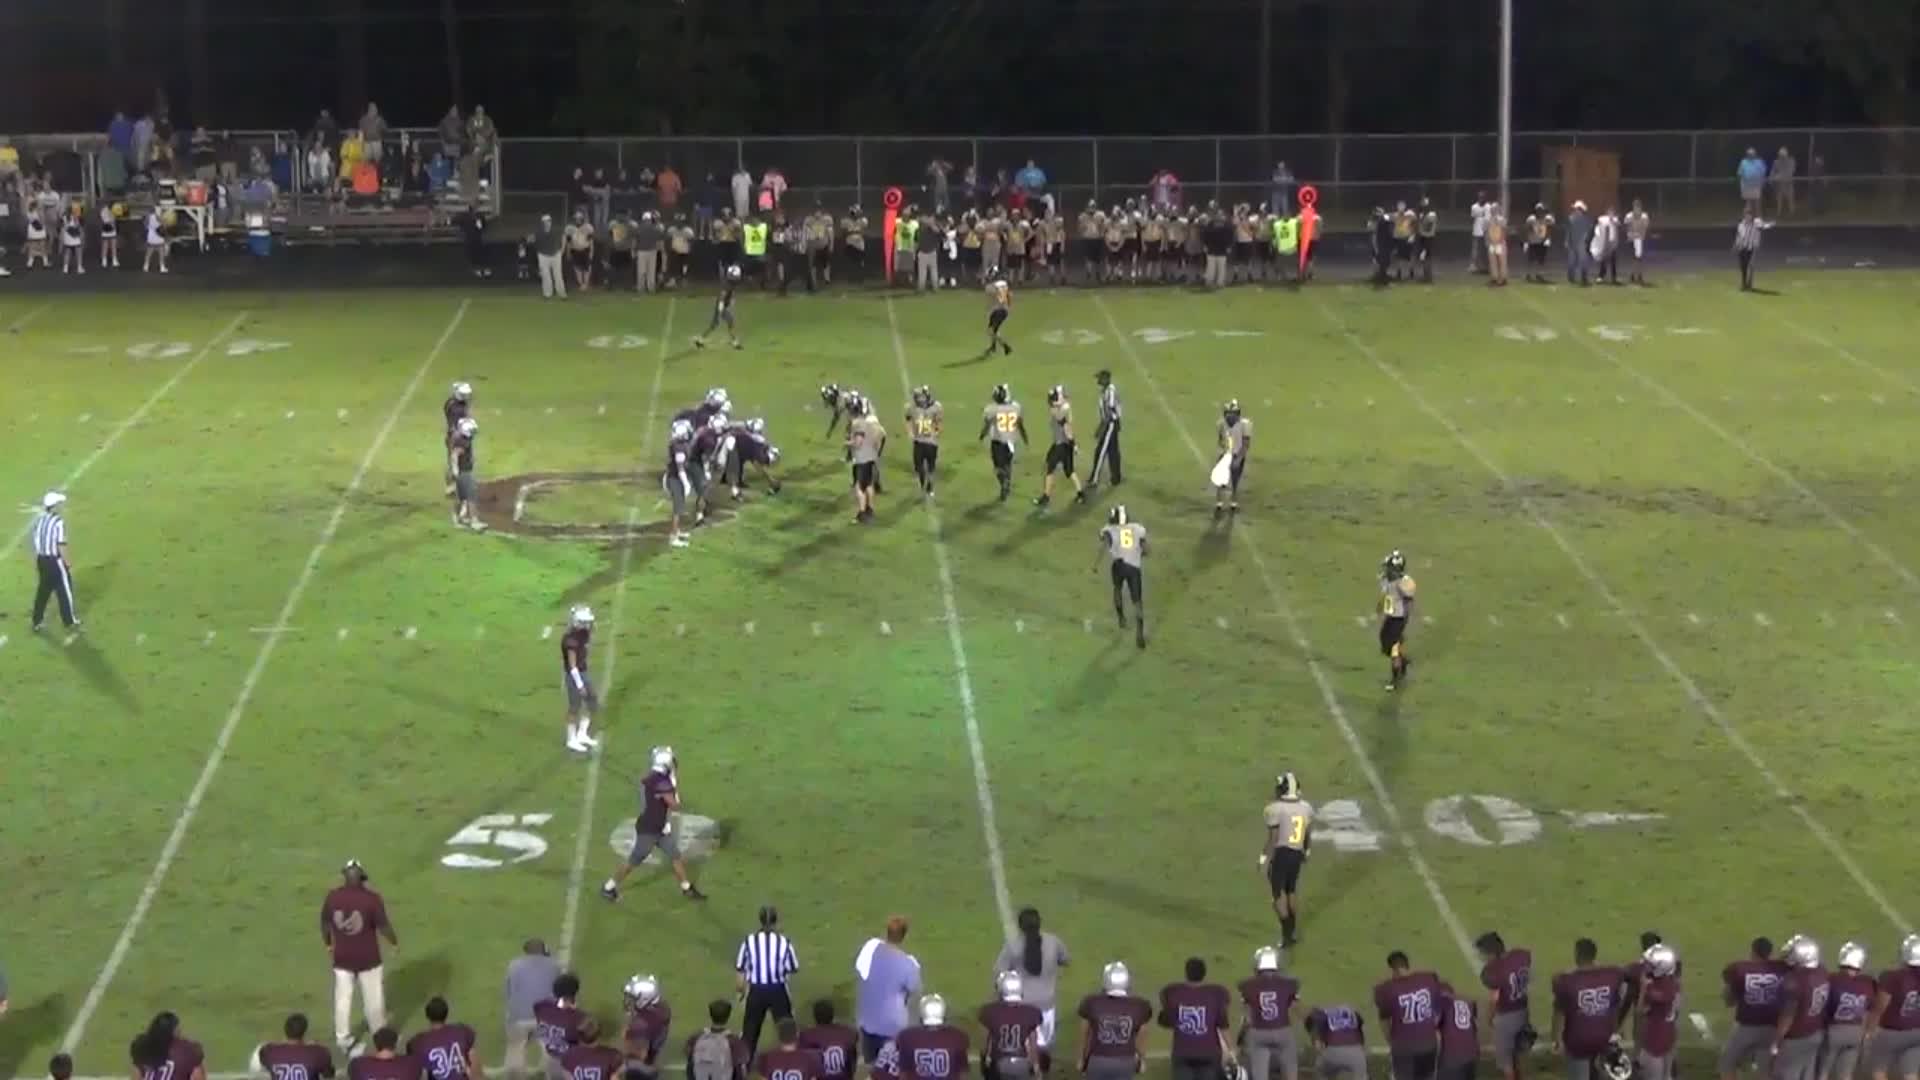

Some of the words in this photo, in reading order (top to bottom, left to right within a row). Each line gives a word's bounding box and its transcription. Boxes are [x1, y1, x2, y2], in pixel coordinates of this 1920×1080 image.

[996, 412, 1018, 432] 22
[1120, 528, 1133, 548] 6
[1288, 815, 1305, 844] 3
[1259, 991, 1279, 1020] 5
[1398, 989, 1433, 1023] 72
[428, 1042, 466, 1079] 34
[914, 1048, 950, 1077] 50
